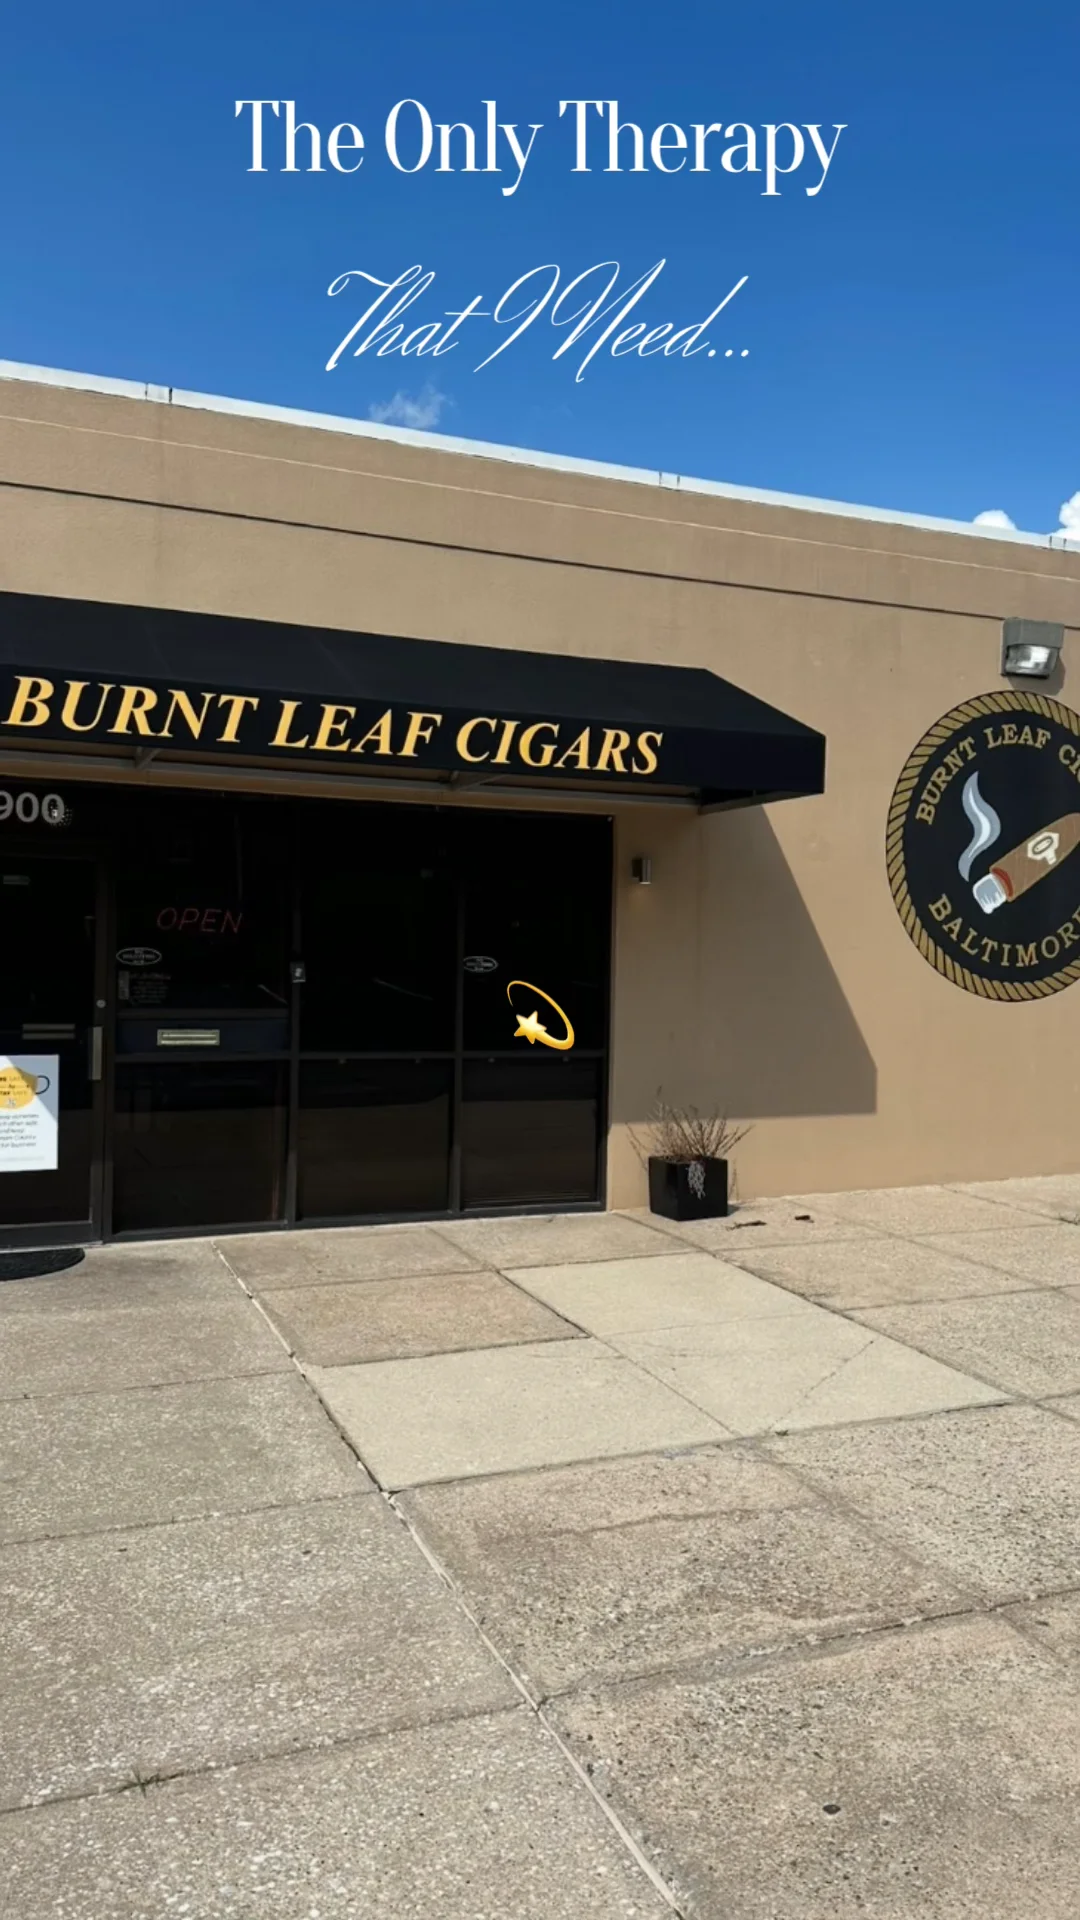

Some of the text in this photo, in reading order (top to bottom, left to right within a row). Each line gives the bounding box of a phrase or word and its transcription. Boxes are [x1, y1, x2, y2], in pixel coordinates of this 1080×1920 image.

[2, 675, 663, 774] BURNT LEAF CIGARS
[916, 736, 977, 825] BURNT
[983, 723, 1051, 749] LEAF
[156, 906, 243, 934] OPEN
